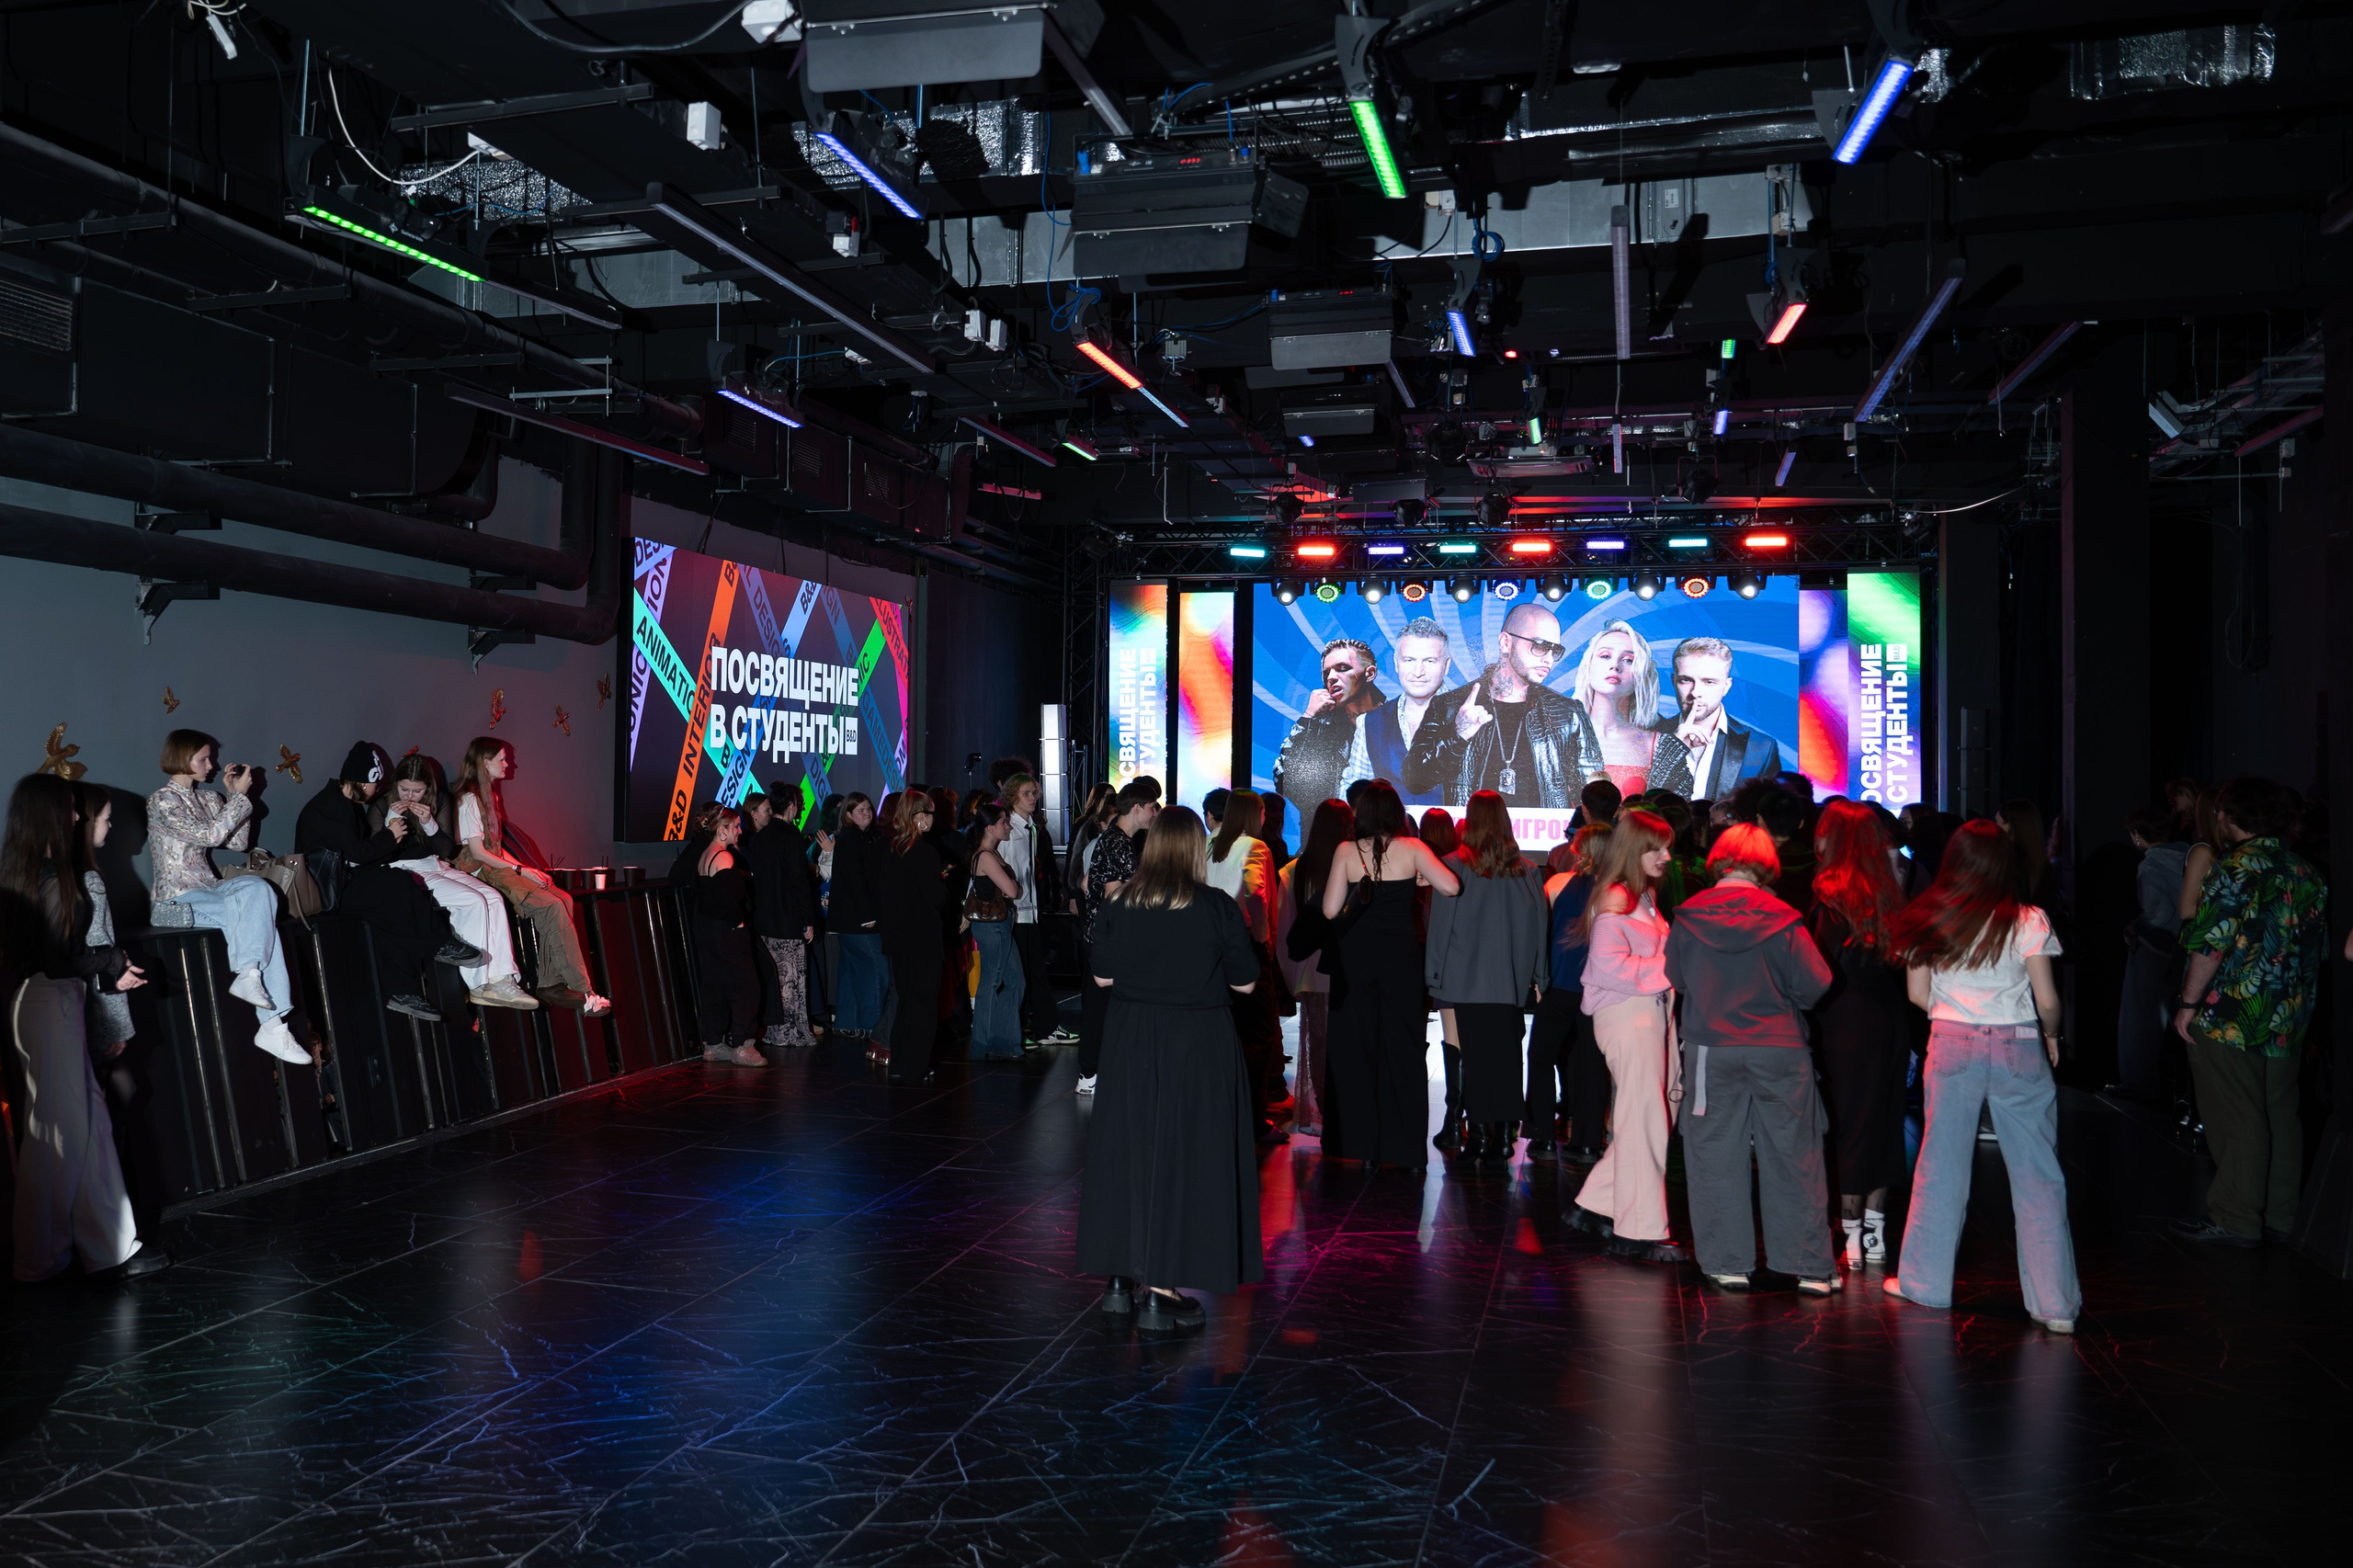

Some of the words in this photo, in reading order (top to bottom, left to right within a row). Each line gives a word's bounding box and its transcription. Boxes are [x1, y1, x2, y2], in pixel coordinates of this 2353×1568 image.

[636, 615, 697, 716] ANIMATIO
[753, 585, 783, 661] DESIG
[711, 645, 859, 710] ПОСВЯЩЕНИЕ
[1119, 648, 1139, 790] СВЯЩЕНИЕ
[1140, 665, 1160, 778] ТУДЕНТЫ
[710, 703, 727, 749] В
[732, 705, 845, 764] СТУДЕНТЫ
[846, 729, 857, 743] B&D
[1860, 643, 1886, 807] ОСВЯЩЕНИЕ
[1886, 662, 1913, 803] СТУДЕНТЫ
[721, 743, 751, 807] ESIGN
